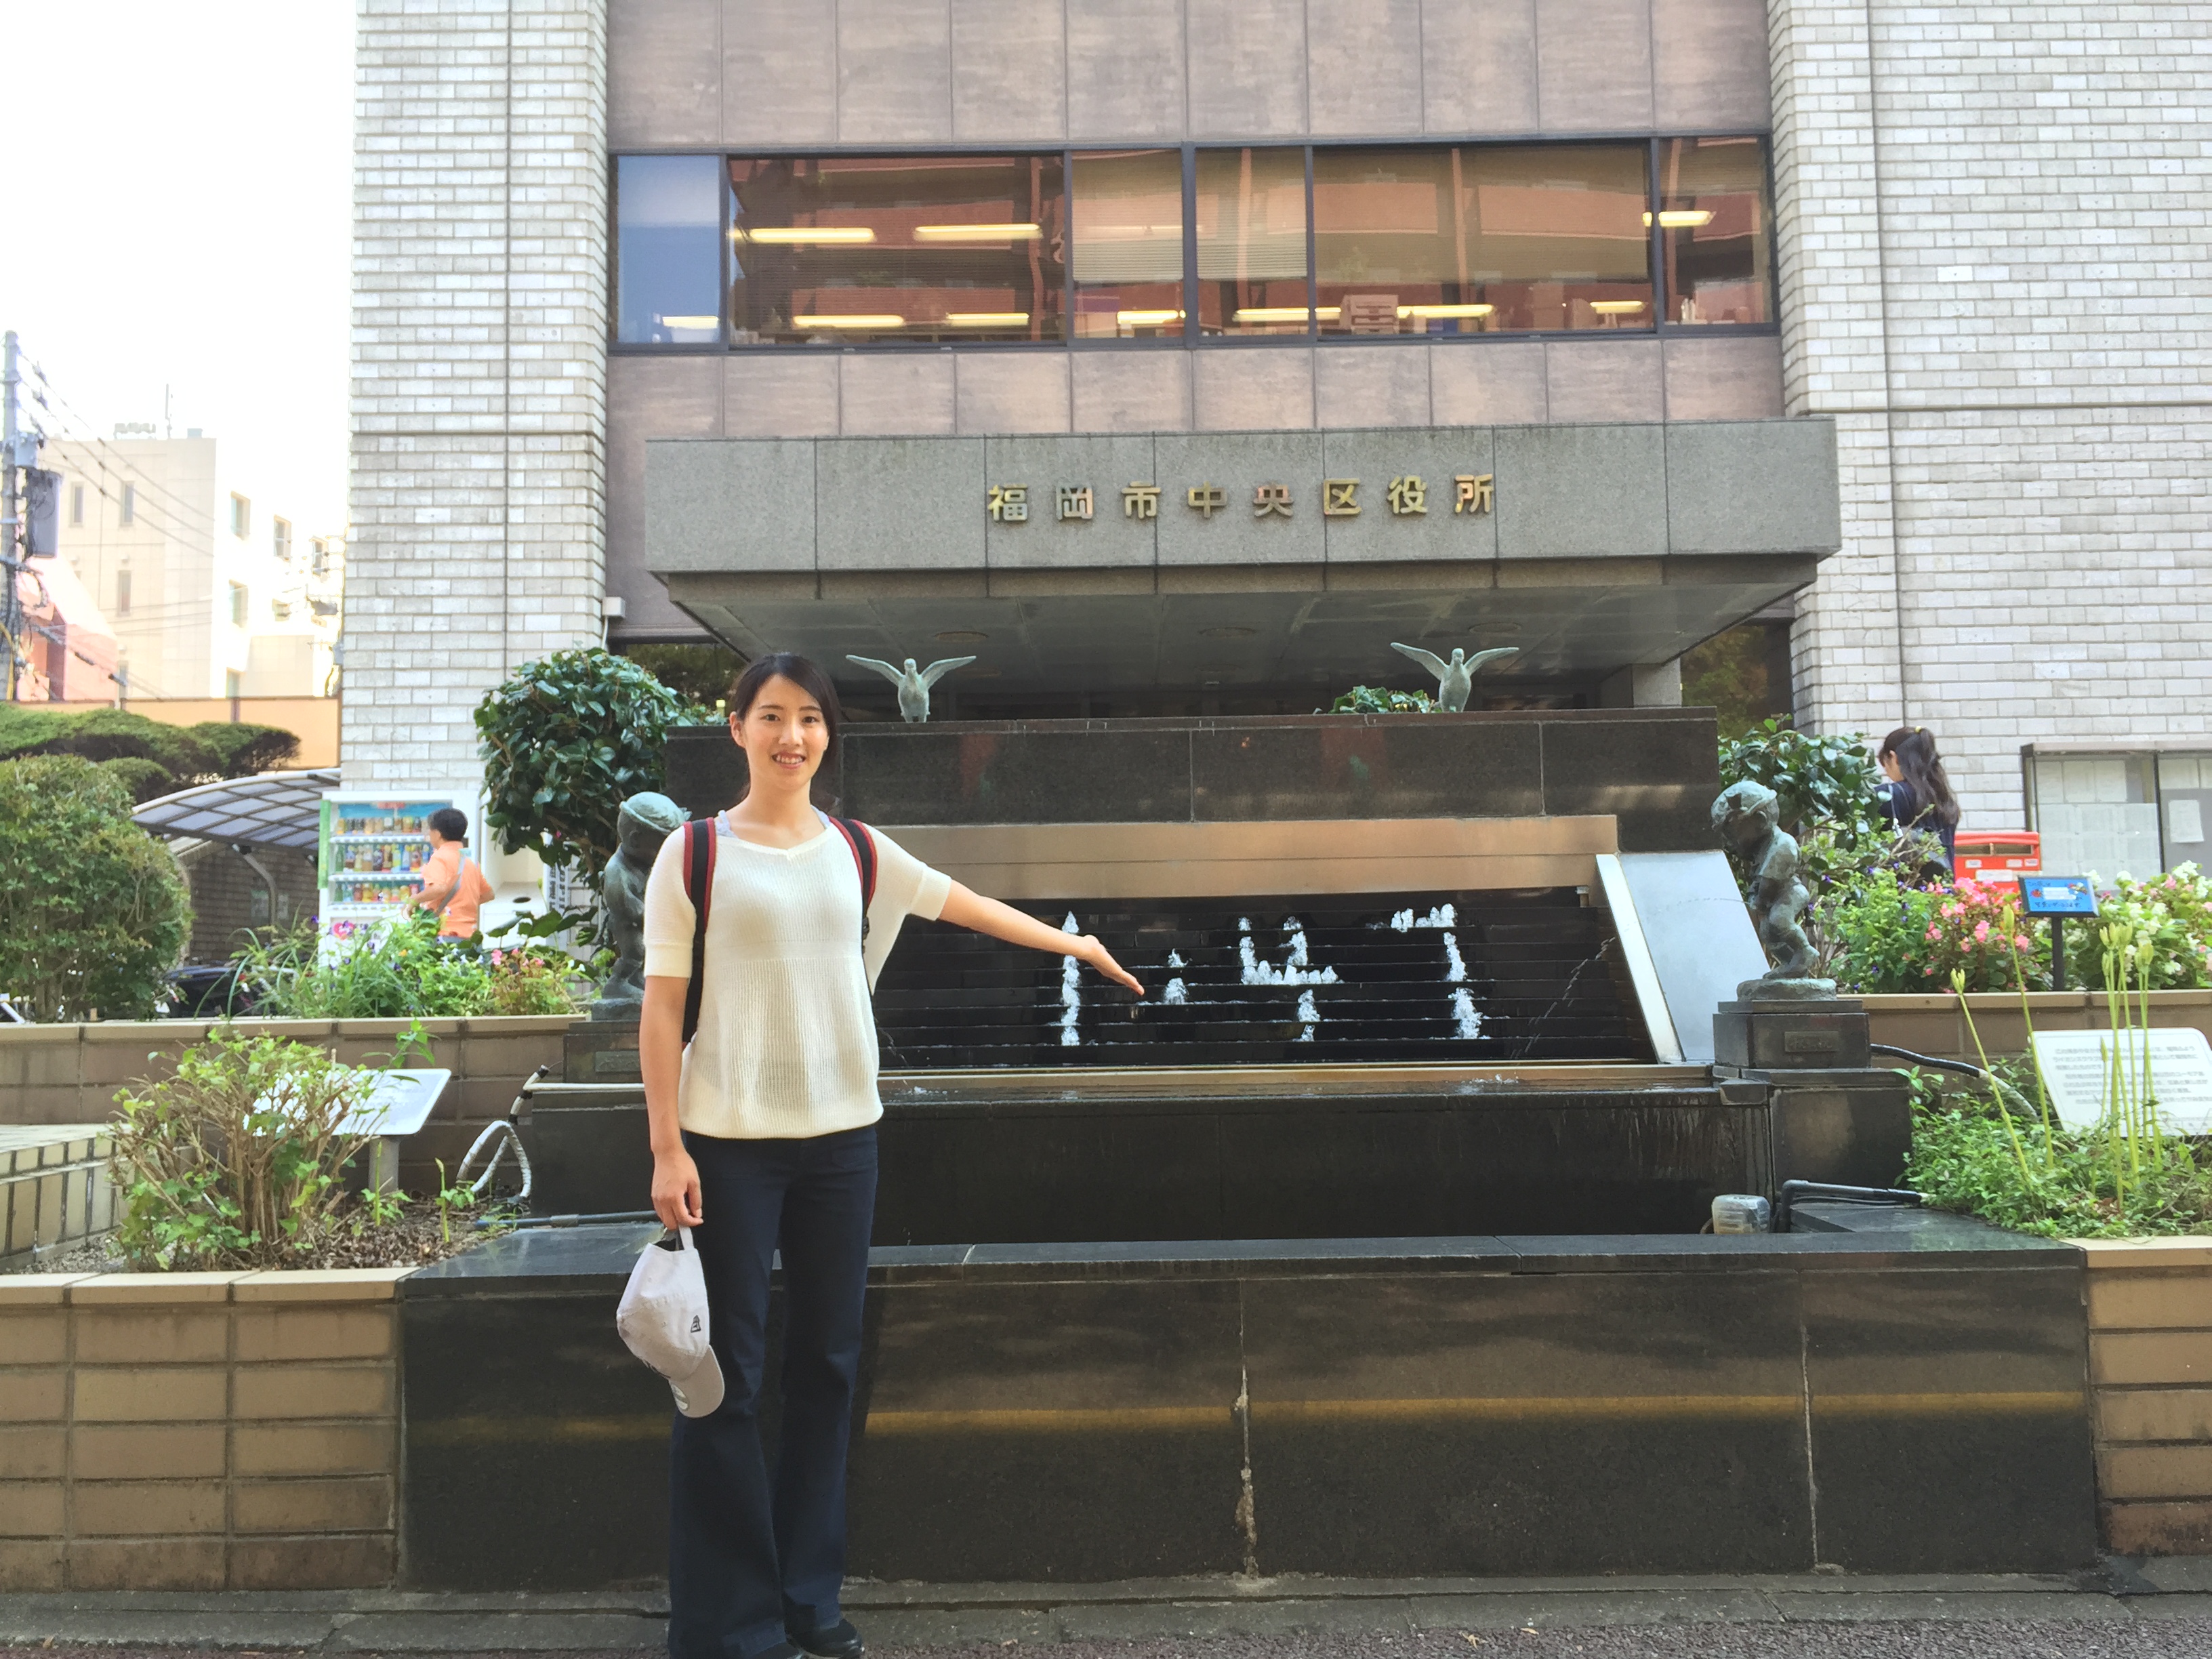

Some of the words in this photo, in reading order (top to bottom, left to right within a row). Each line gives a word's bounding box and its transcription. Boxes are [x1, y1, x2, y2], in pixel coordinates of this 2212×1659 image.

[988, 474, 1494, 521] 福岡市中央区役所
